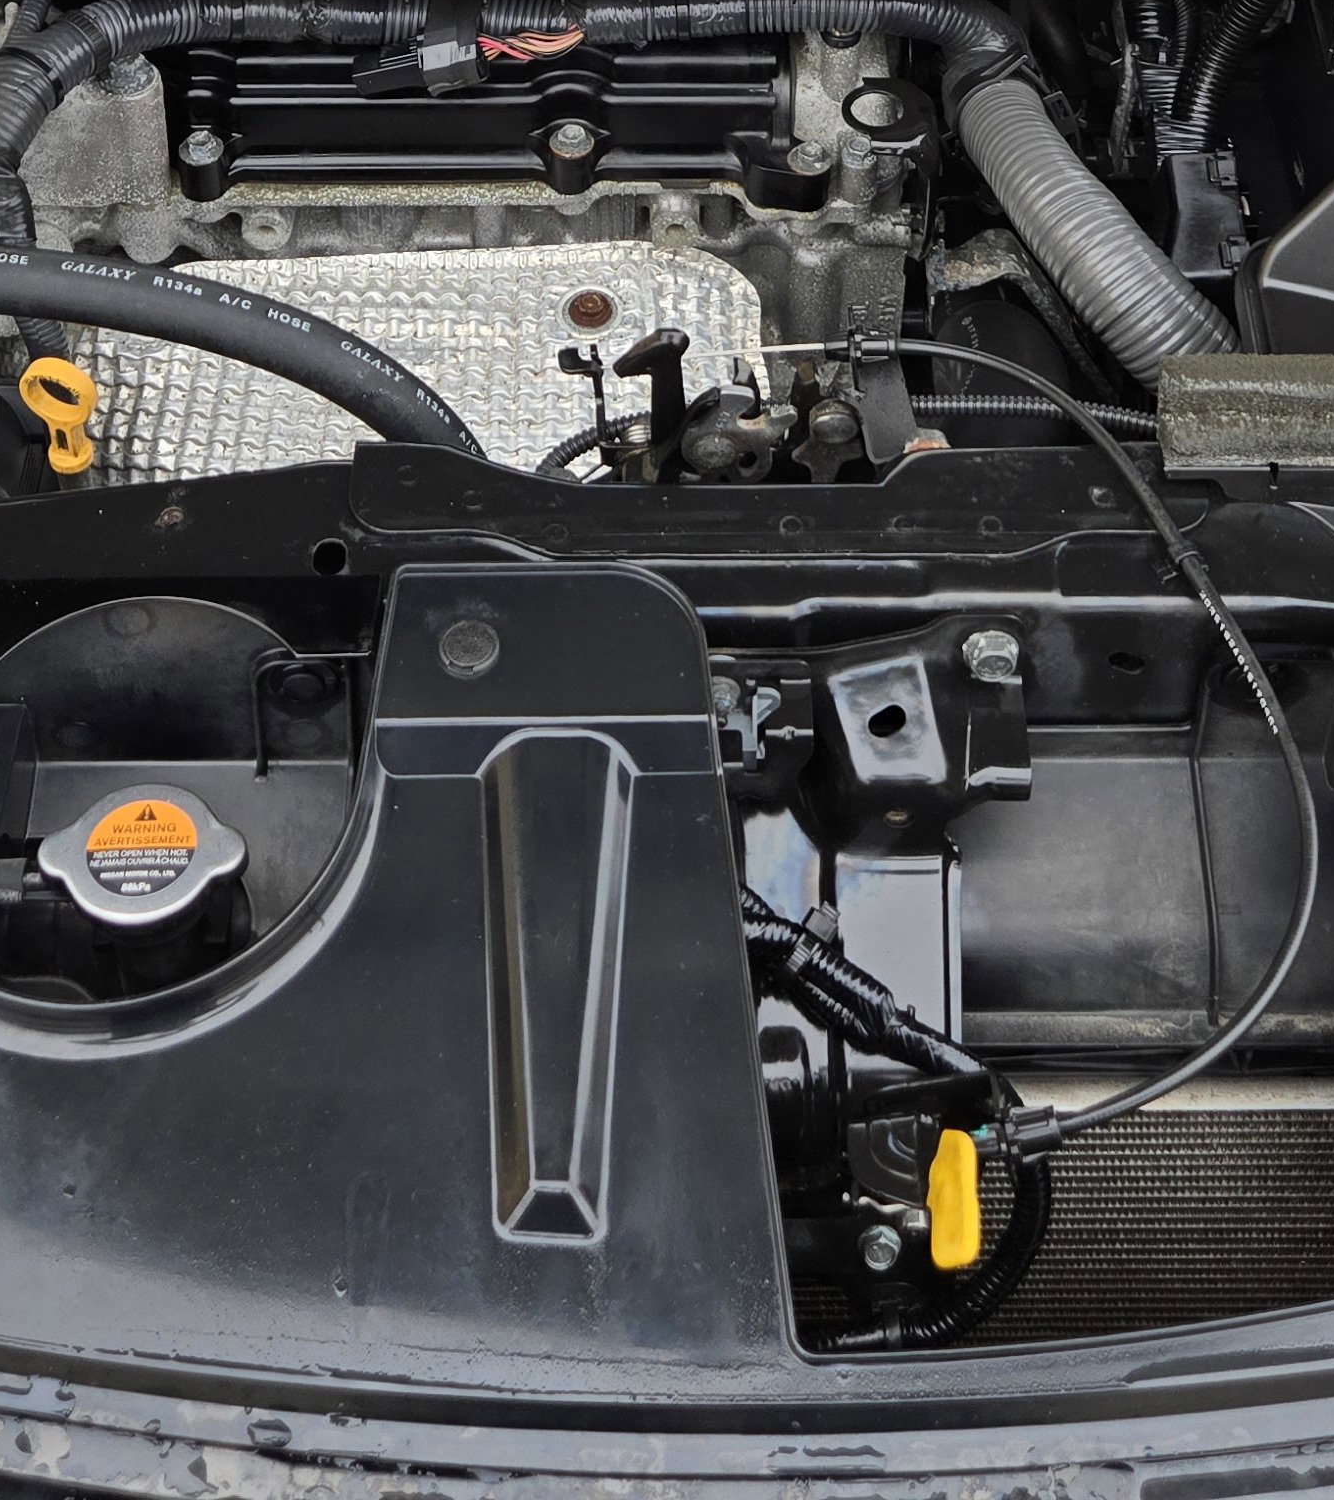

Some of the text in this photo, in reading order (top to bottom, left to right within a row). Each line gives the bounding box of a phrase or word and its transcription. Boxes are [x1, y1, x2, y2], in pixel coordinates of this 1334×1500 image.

[60, 260, 137, 281] GALAXY
[153, 275, 203, 296] R134a
[218, 292, 253, 310] A/C
[267, 307, 312, 333] HOSE
[340, 340, 405, 383] GALAXY
[417, 387, 451, 425] R134a
[112, 822, 177, 834] WARNING
[94, 835, 191, 846] AVERTISSEMENT
[93, 850, 119, 859] NEVER
[121, 849, 143, 857] OPEN
[144, 848, 169, 857] WHEN
[100, 858, 126, 867] JAMAIS
[127, 857, 154, 866] OUVRIR
[100, 871, 124, 879] NISSAN
[125, 870, 148, 878] MOTOR
